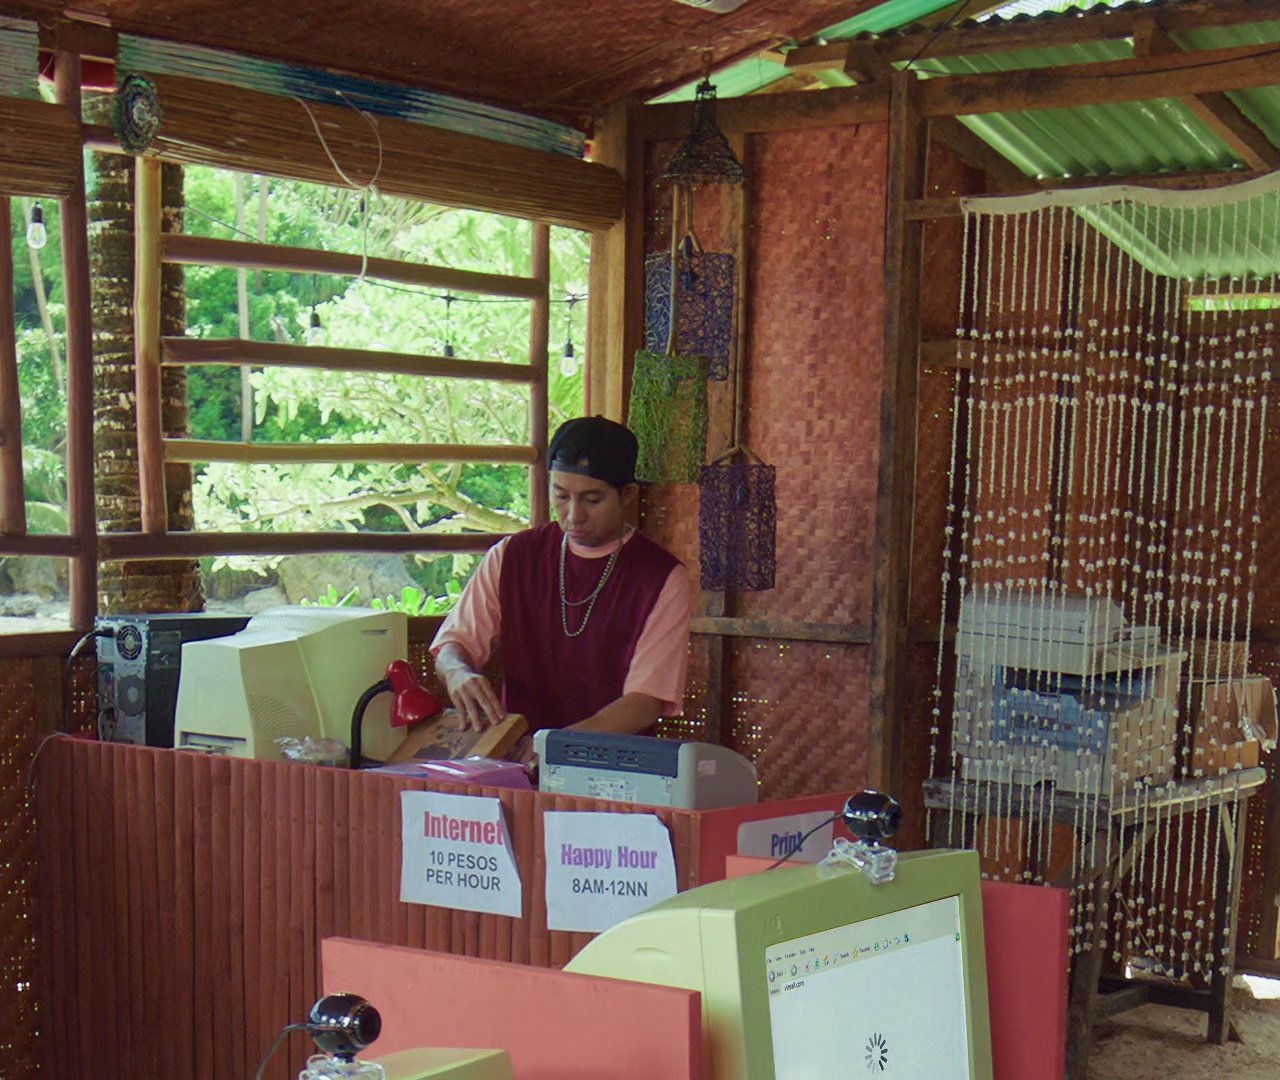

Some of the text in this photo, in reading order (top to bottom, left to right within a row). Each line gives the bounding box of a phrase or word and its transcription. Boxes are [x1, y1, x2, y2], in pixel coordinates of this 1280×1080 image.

[424, 810, 503, 845] Internet
[429, 850, 498, 872] 10 PESOS
[561, 843, 658, 869] Happy Hour
[426, 868, 501, 891] PER HOUR
[572, 878, 648, 897] 8AM-12NN
